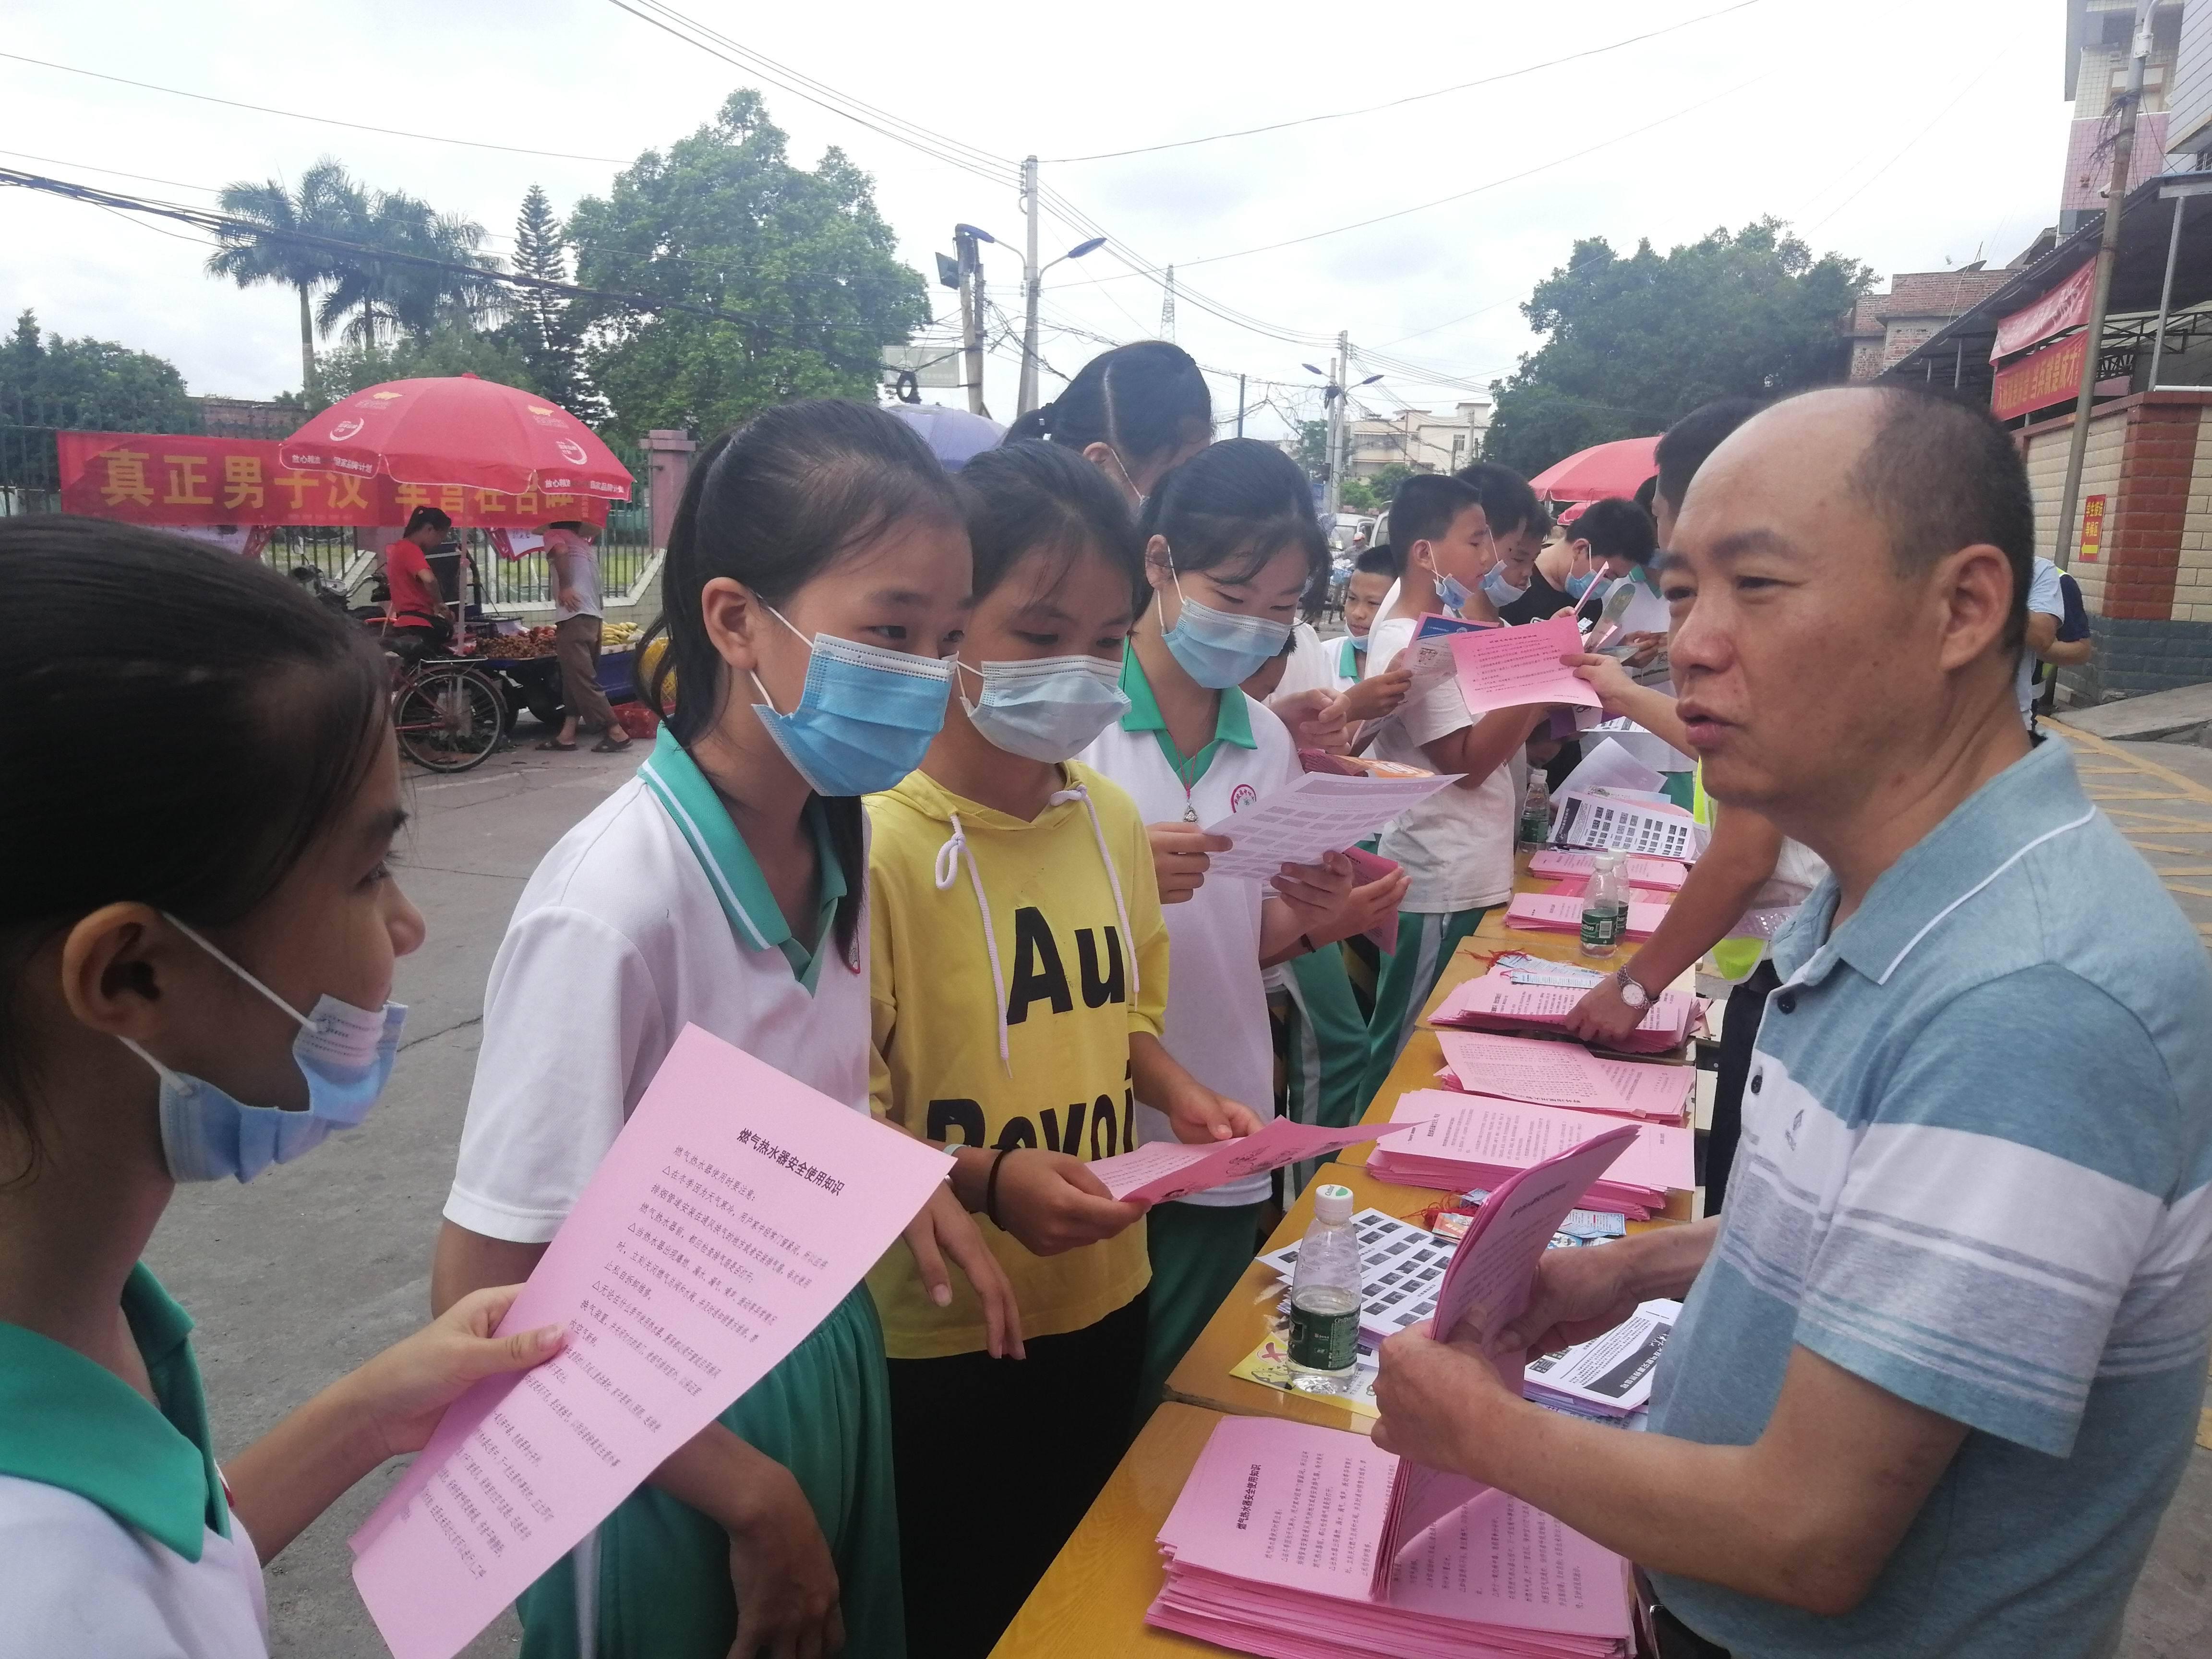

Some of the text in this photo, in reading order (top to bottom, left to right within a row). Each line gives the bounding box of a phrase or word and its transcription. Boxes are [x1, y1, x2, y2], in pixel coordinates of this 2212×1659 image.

[99, 448, 369, 510] 真正男子汉
[1007, 906, 1125, 1025] Au
[737, 1127, 845, 1197] 燃气热水器安全使用知识
